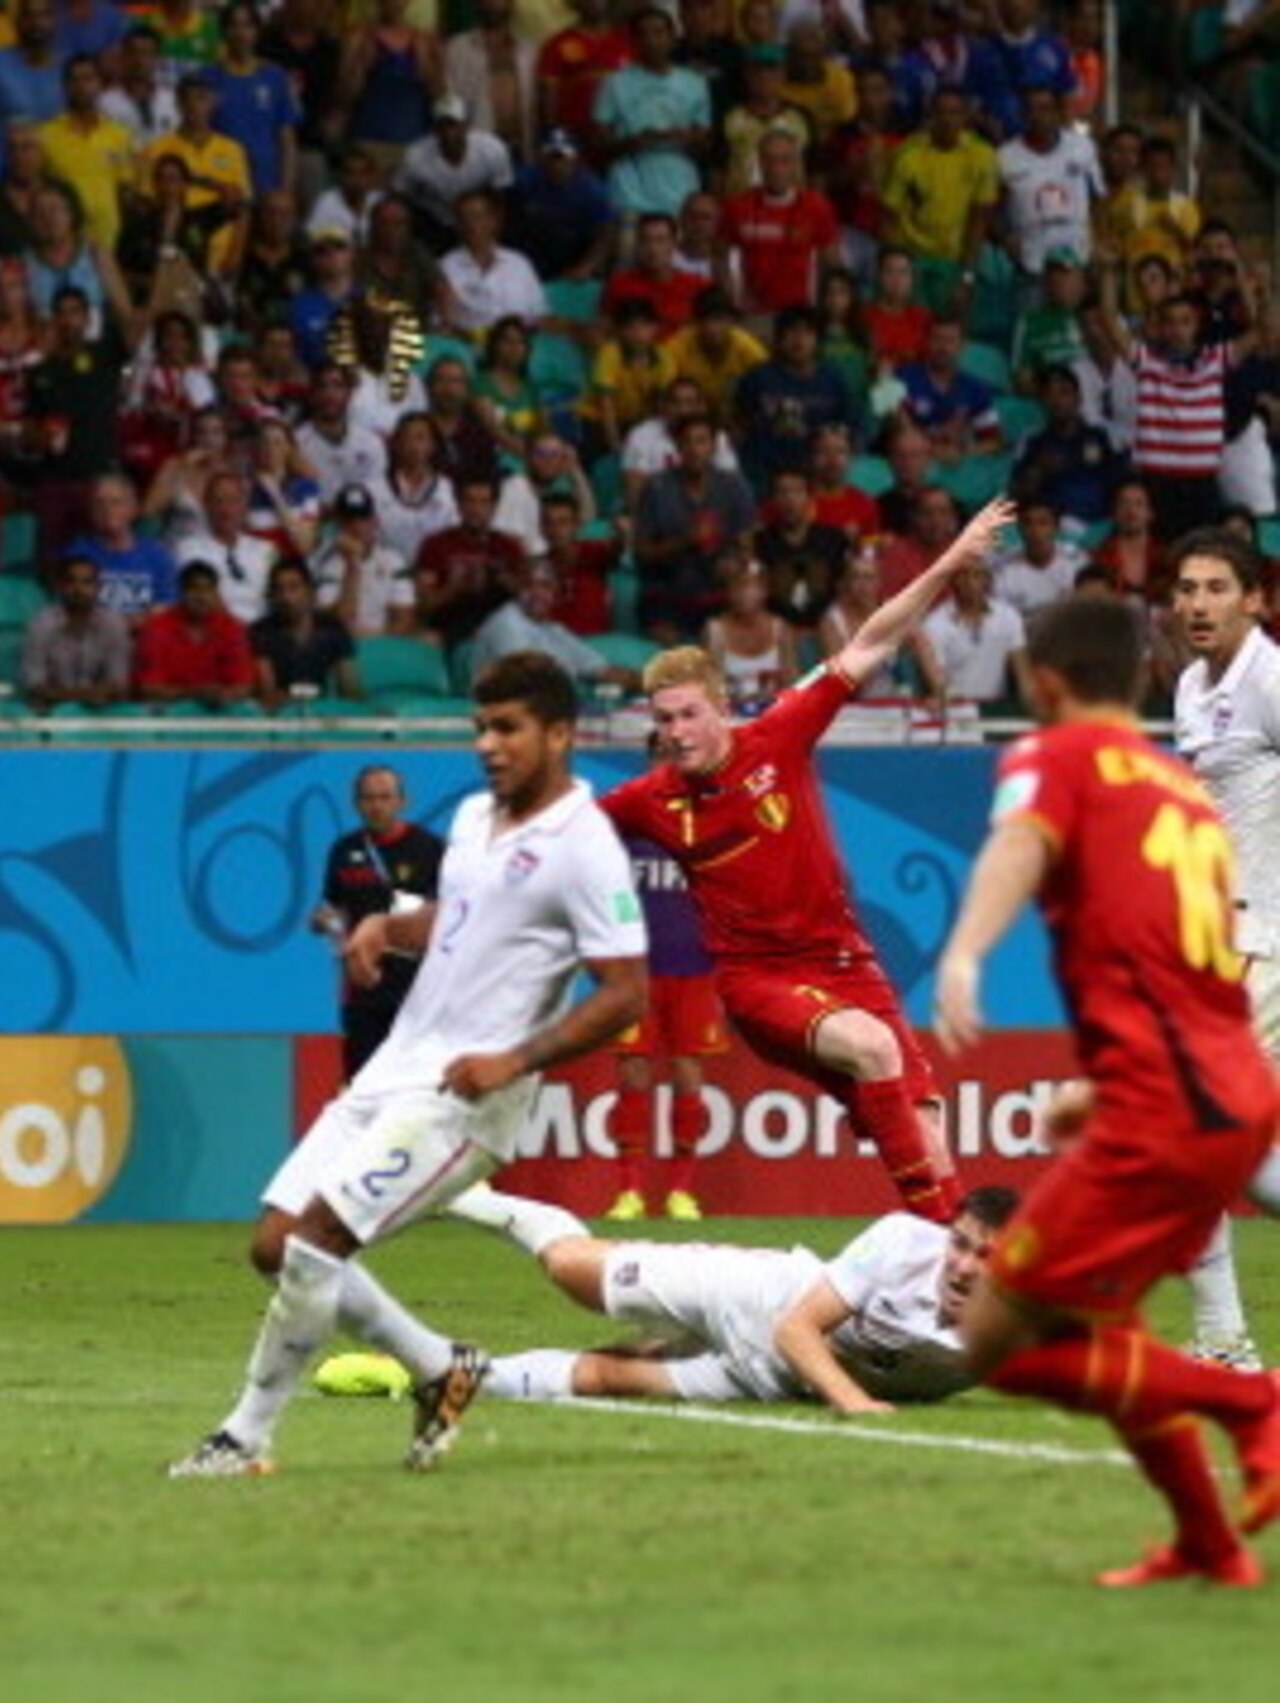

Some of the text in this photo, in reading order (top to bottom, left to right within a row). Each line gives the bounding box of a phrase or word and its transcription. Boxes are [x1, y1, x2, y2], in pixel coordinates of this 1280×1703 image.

[630, 860, 688, 890] FIF
[1141, 803, 1242, 982] 10
[360, 1147, 411, 1197] 2
